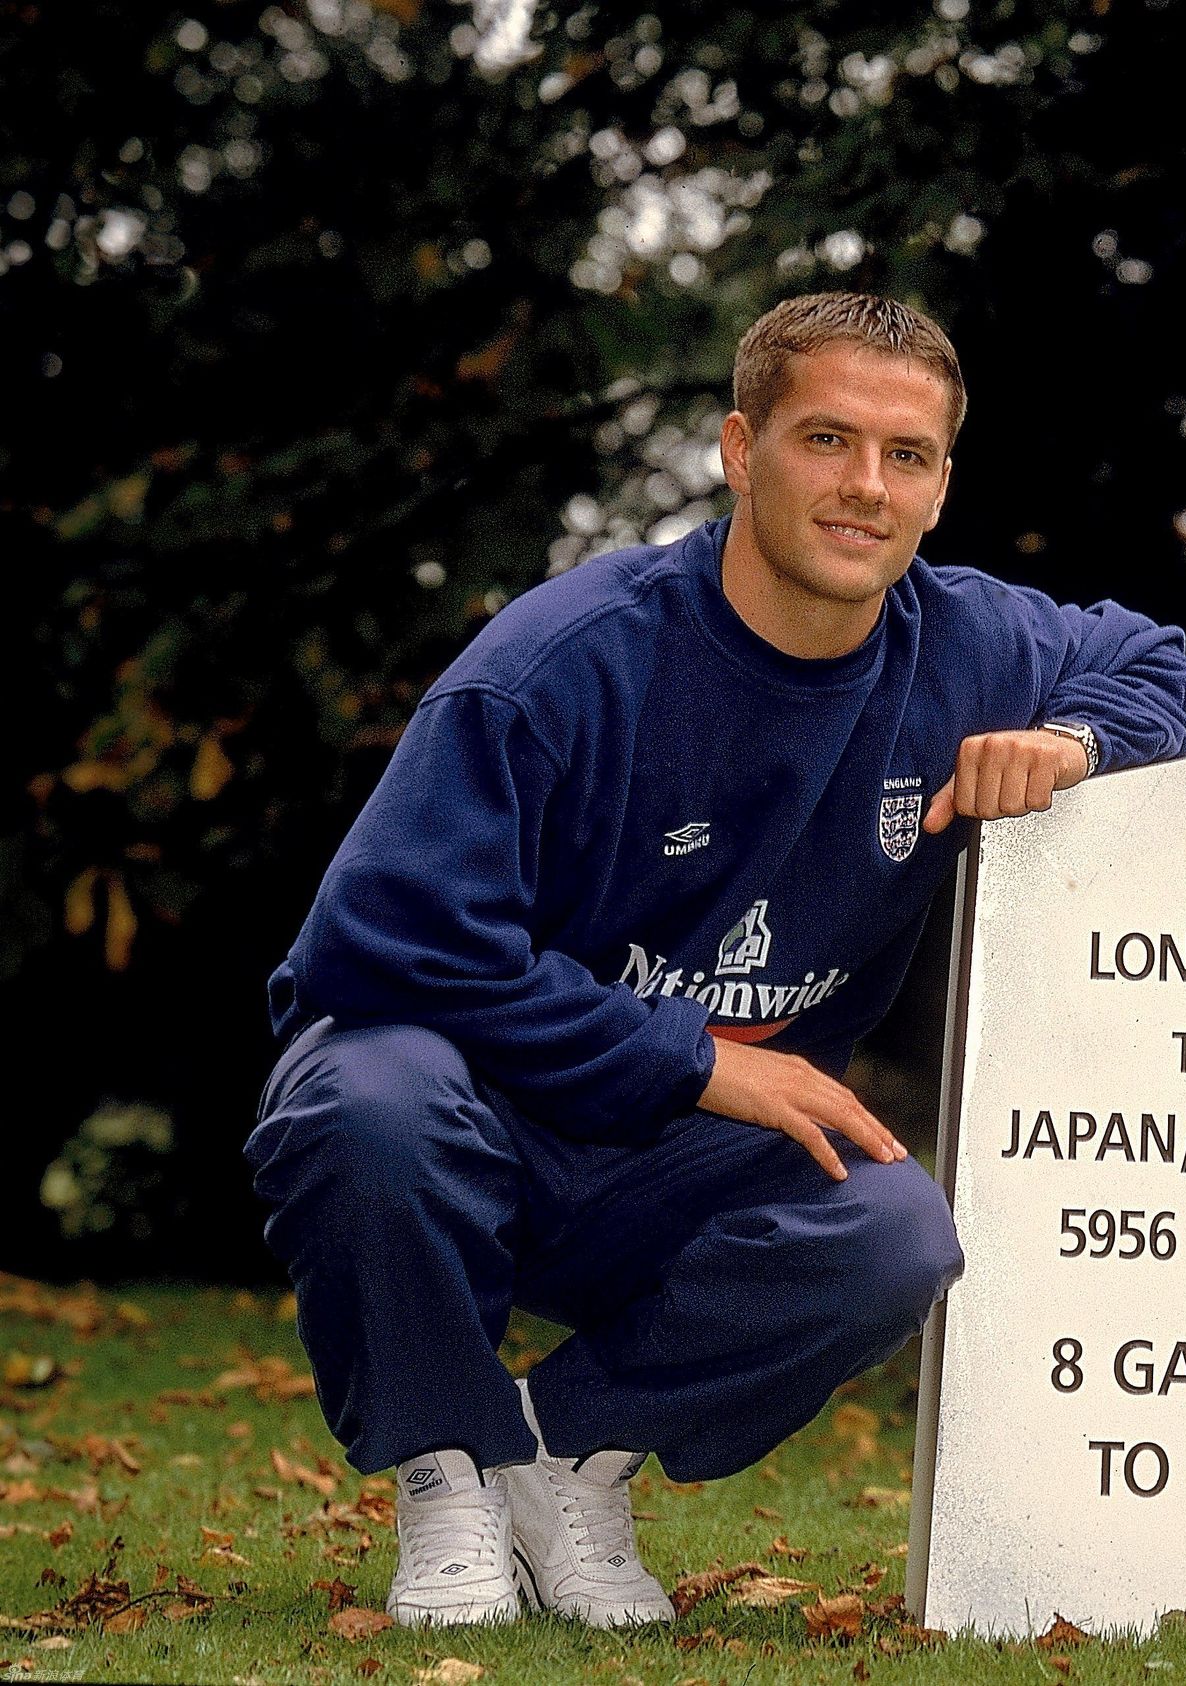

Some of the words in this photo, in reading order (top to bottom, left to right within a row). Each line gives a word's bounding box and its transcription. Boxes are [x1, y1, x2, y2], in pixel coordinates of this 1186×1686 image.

[883, 776, 922, 790] ENGLAND
[664, 834, 710, 856] UMBRO
[618, 943, 850, 1019] Ntionwide
[1059, 1208, 1177, 1261] 5956
[1050, 1337, 1084, 1393] 8
[409, 1477, 443, 1497] UMBRO
[1088, 1440, 1170, 1498] TO
